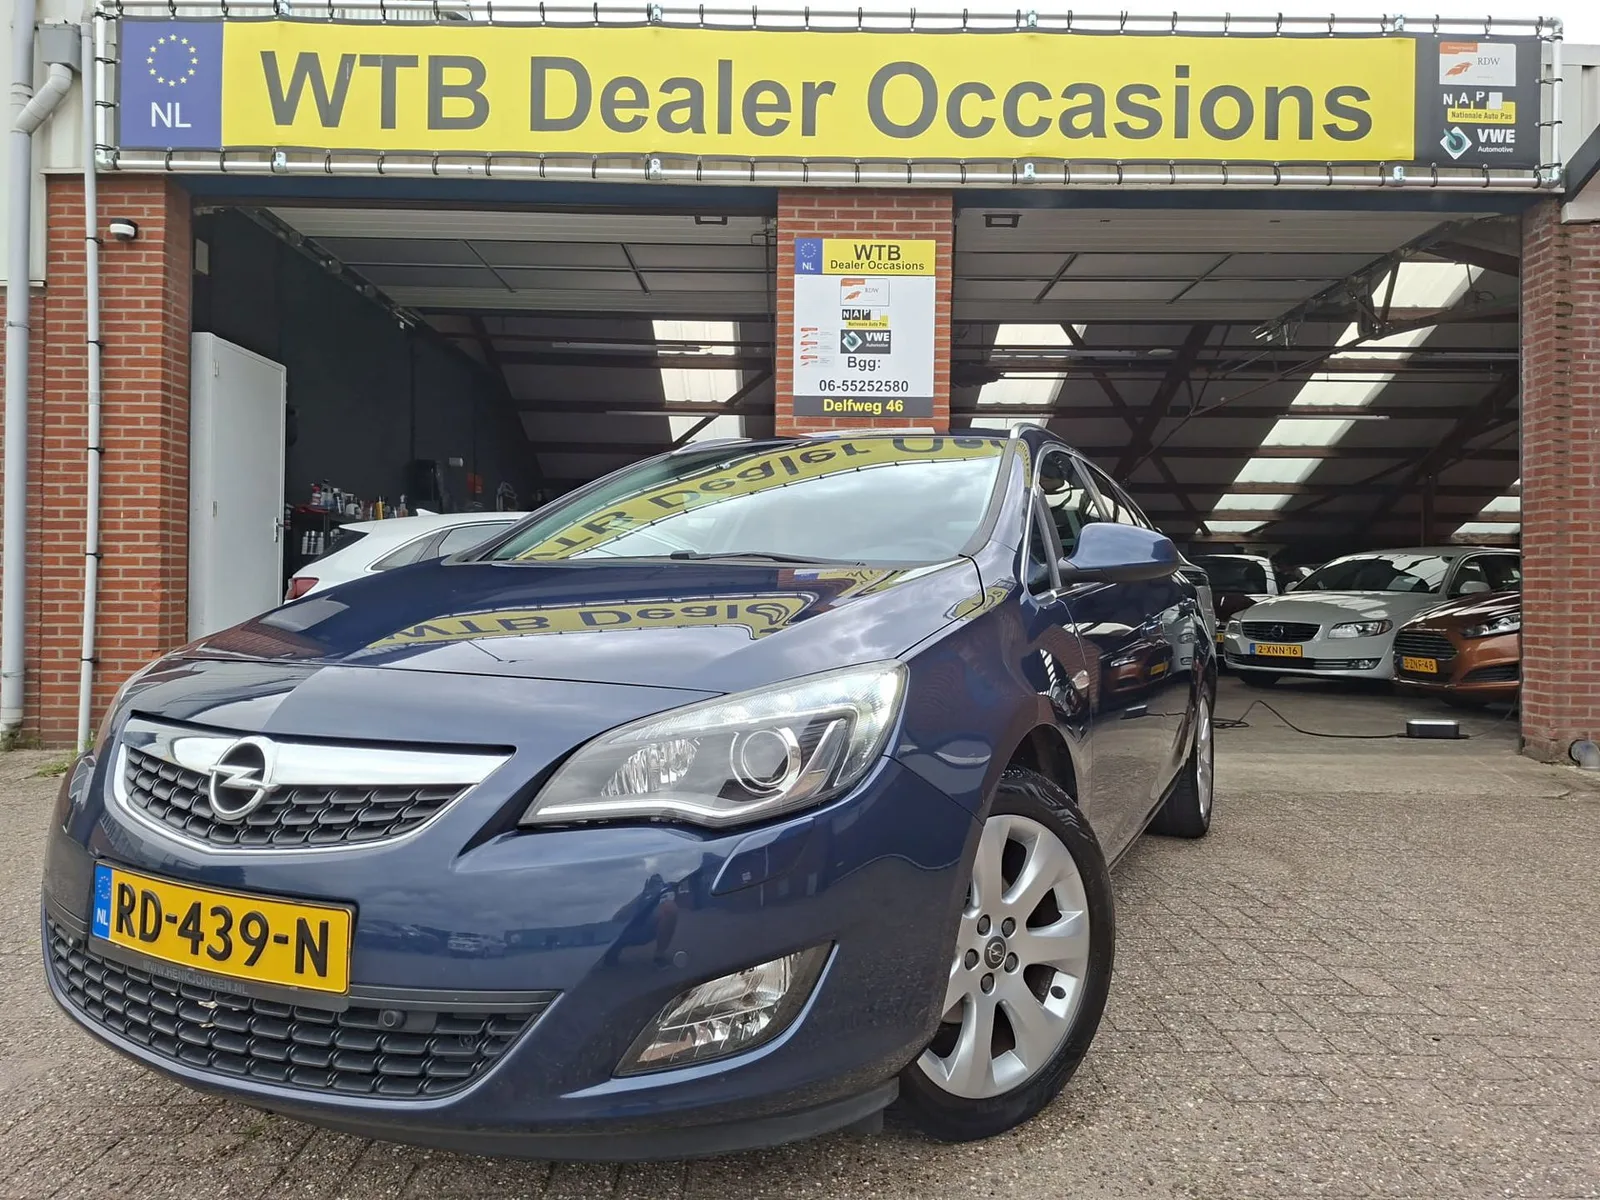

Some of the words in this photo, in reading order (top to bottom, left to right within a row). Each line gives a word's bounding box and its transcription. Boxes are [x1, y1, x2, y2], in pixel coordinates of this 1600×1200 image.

[1477, 57, 1500, 66] RDW
[260, 51, 490, 130] WTB
[530, 56, 836, 137] Dealer
[867, 61, 1373, 141] Occasions
[151, 102, 191, 128] NL
[1451, 112, 1482, 120] Nationale
[1484, 112, 1499, 120] Auto
[1500, 112, 1512, 120] Pas
[1477, 129, 1515, 143] VWE
[854, 244, 901, 261] WTB
[802, 262, 814, 270] NL
[830, 260, 864, 270] Dealer
[868, 261, 925, 271] Occasions
[865, 332, 890, 342] VWE
[847, 356, 881, 371] Bgg:
[819, 380, 909, 392] 06-55252580
[823, 399, 882, 413] Delfweg
[886, 400, 904, 412] 46
[1258, 645, 1298, 655] 2-XNN-16
[97, 908, 109, 926] NL
[115, 882, 329, 977] RD-439-N
